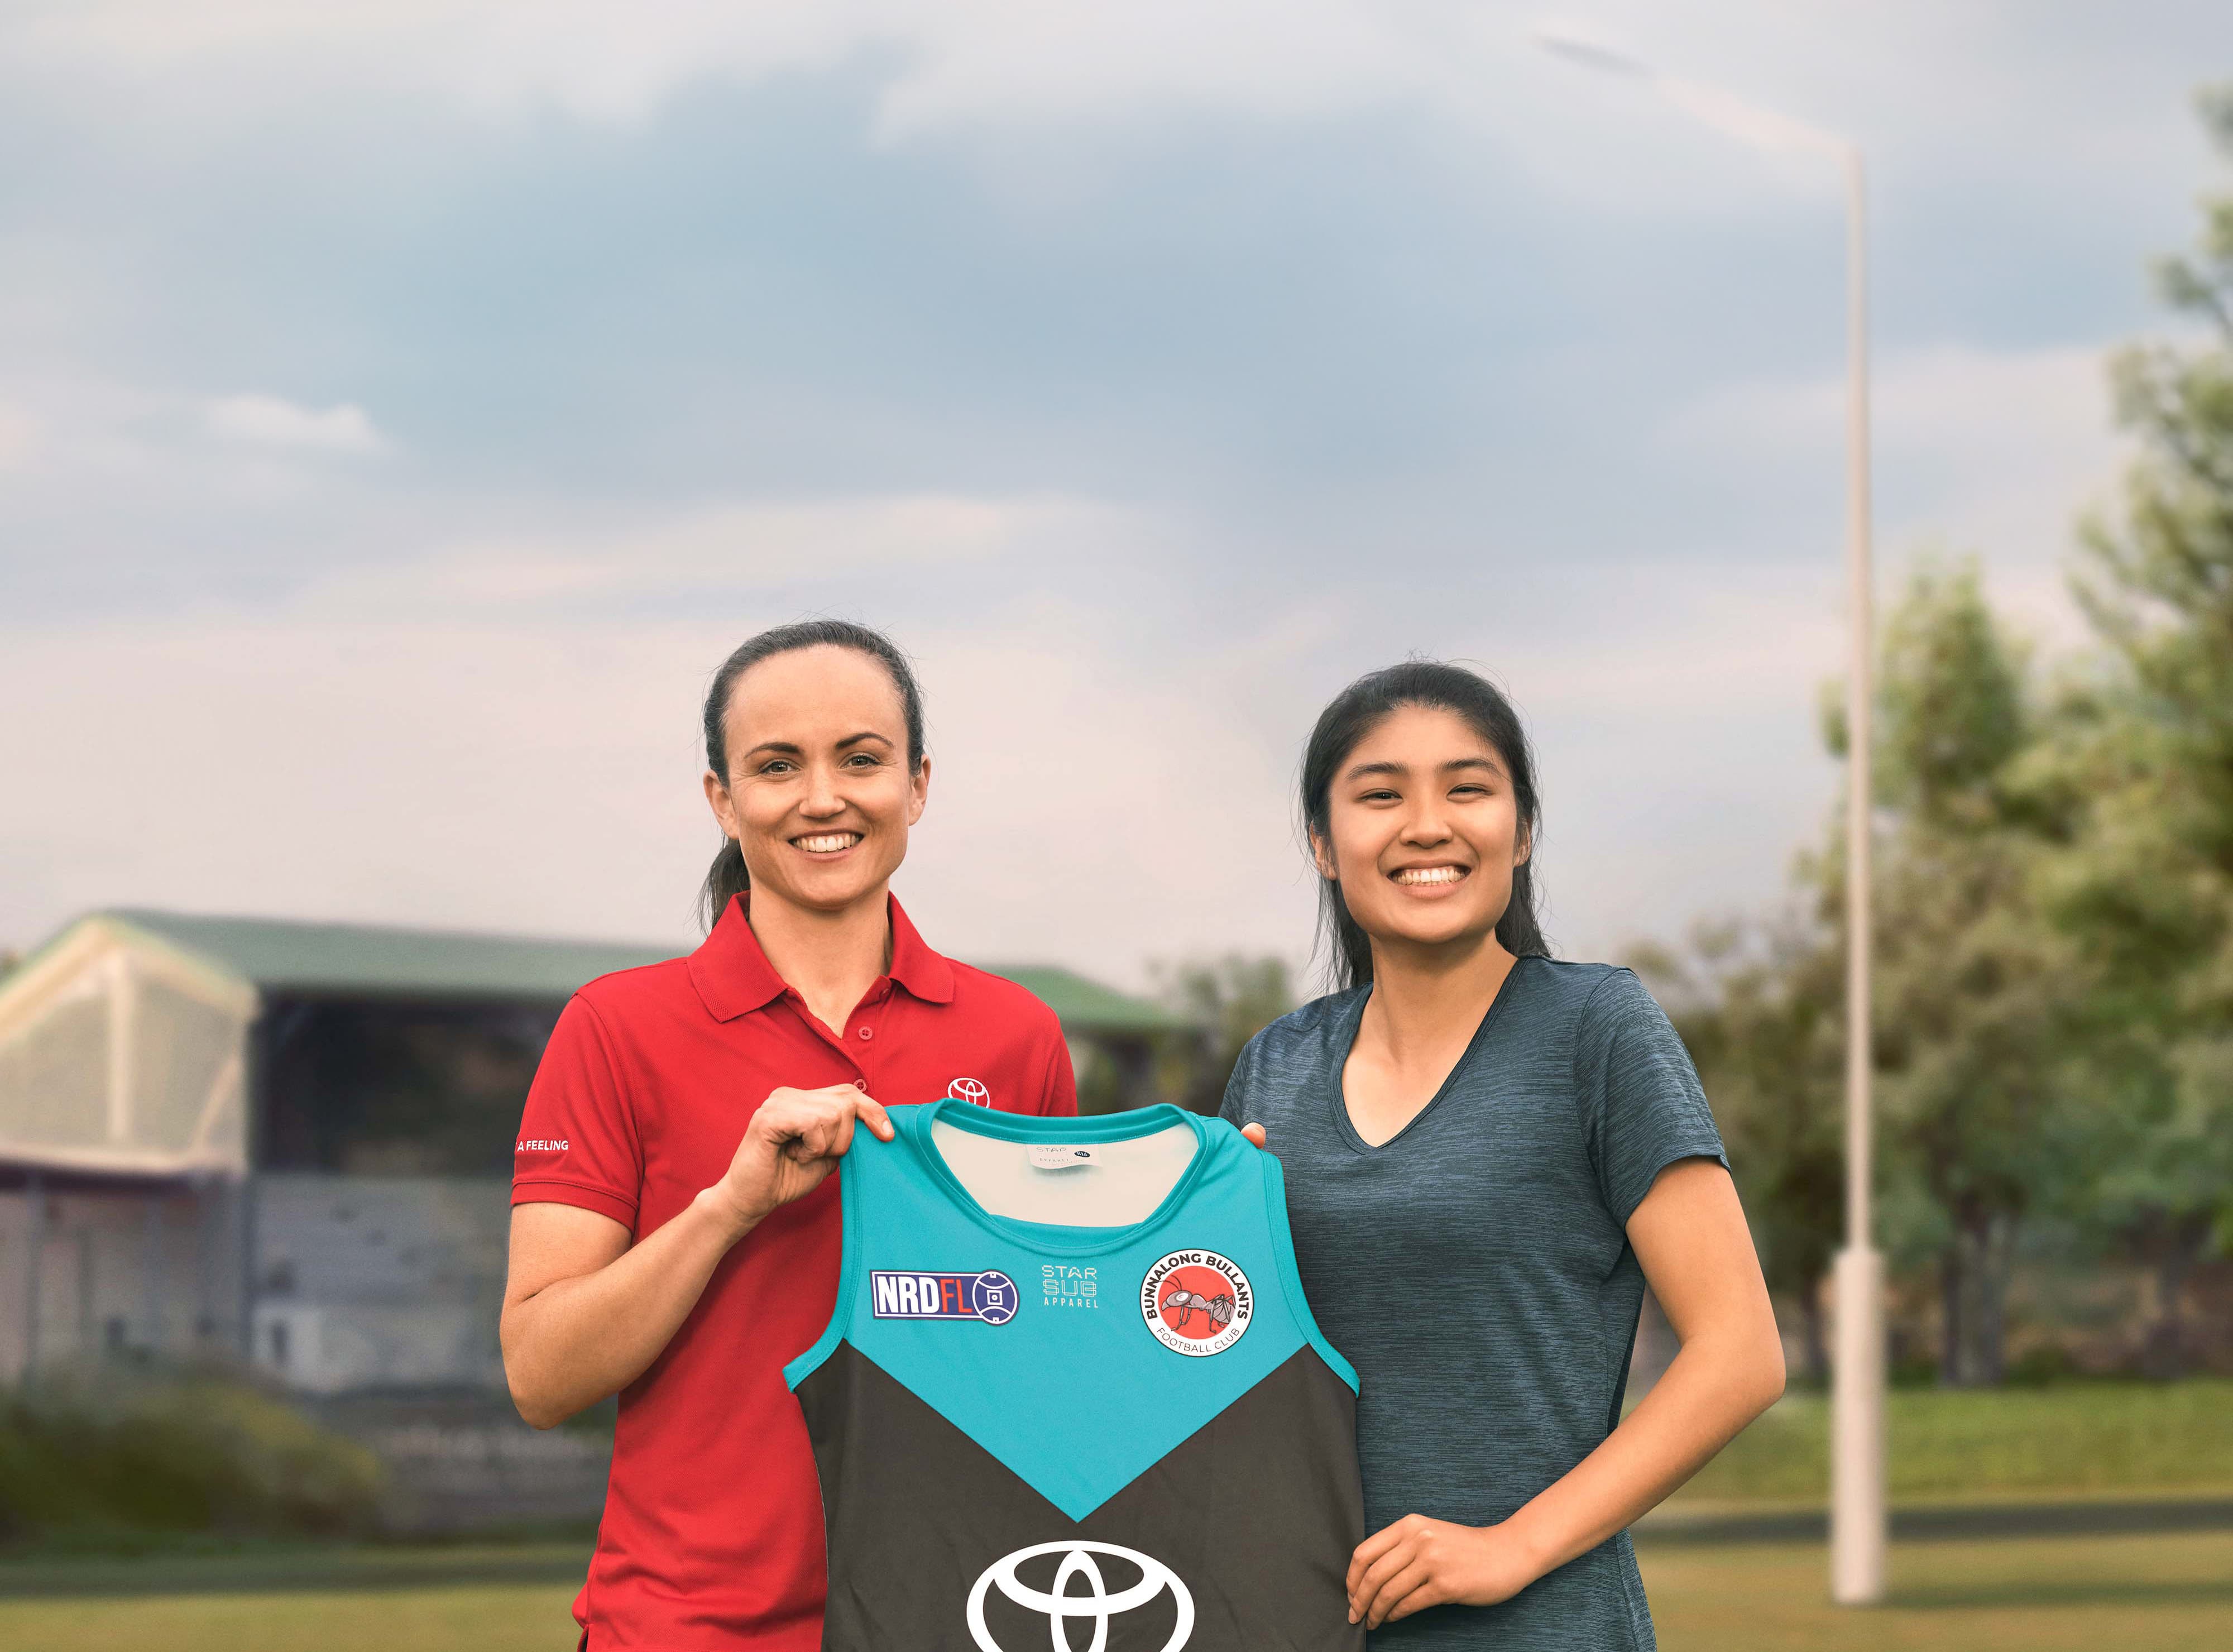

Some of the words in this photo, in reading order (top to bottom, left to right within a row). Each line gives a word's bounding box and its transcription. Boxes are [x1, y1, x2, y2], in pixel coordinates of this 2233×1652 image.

[517, 1141, 524, 1152] A
[526, 1140, 569, 1151] FEELING
[1042, 1265, 1098, 1280] STAR
[877, 1276, 973, 1314] NRDFL
[1042, 1279, 1097, 1297] SUB
[1144, 1253, 1201, 1320] BUNNALONG
[1205, 1256, 1249, 1320] BULLANTS
[1044, 1297, 1099, 1308] APPAREL
[1157, 1328, 1212, 1353] FOOTBALL
[1214, 1328, 1240, 1349] CLUB
